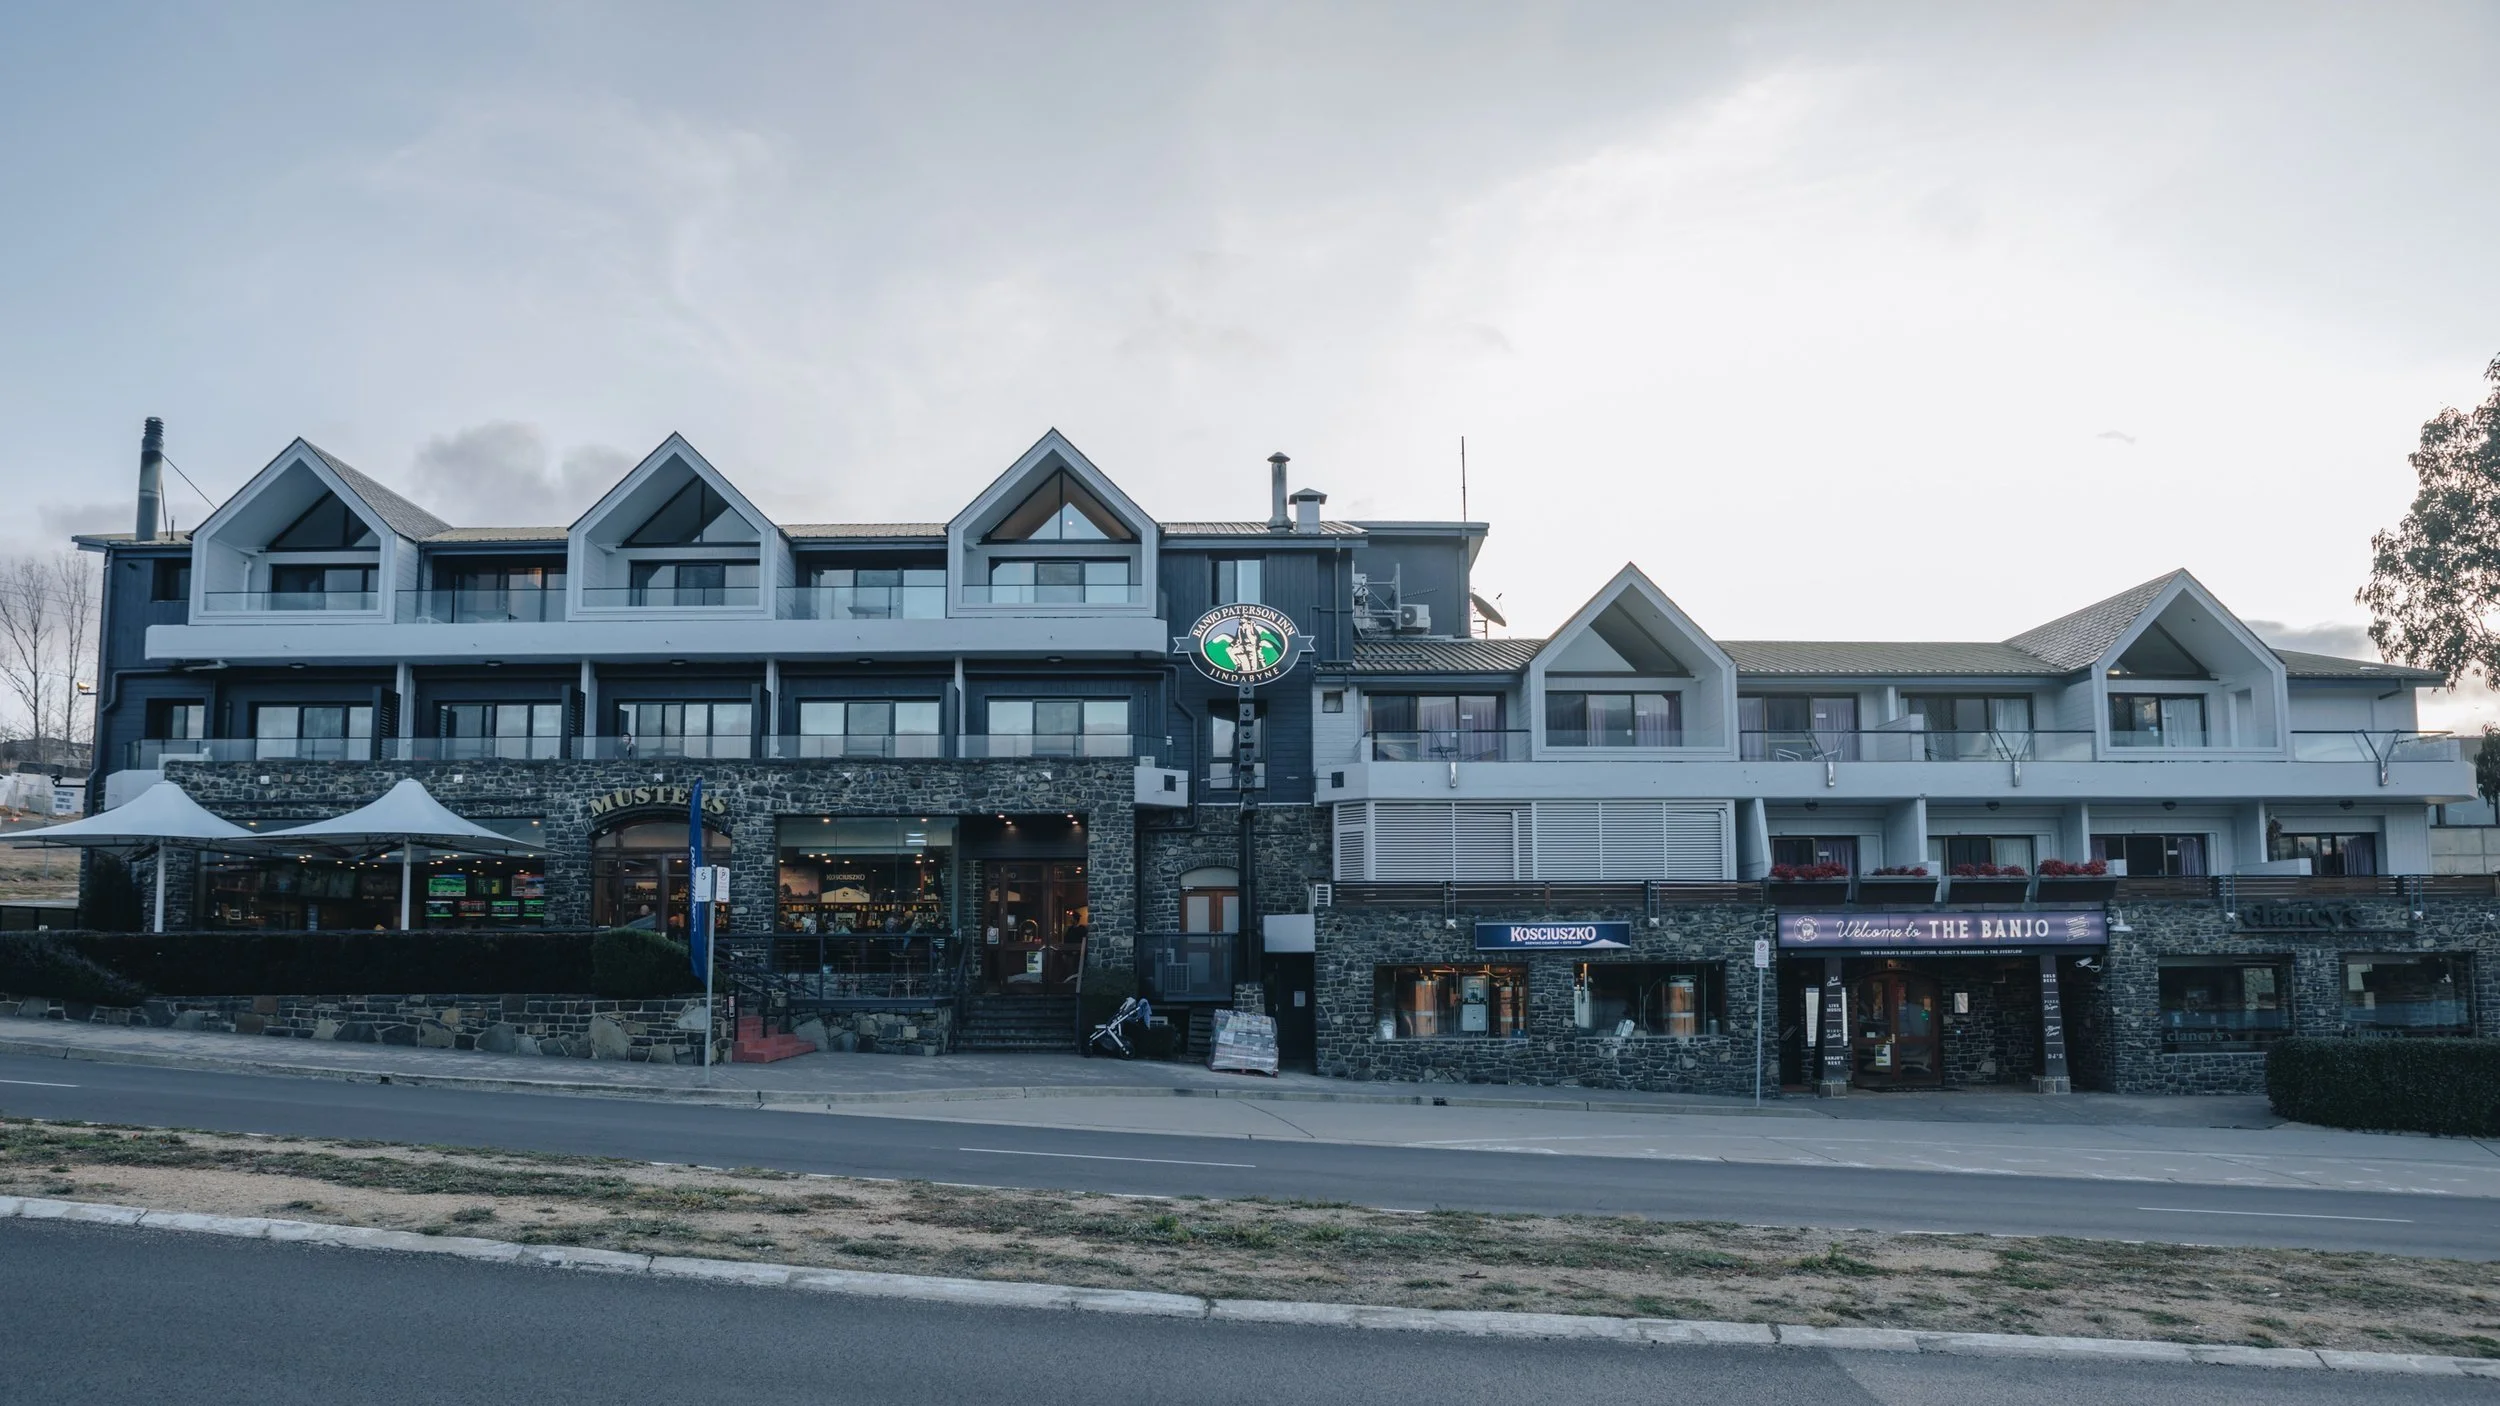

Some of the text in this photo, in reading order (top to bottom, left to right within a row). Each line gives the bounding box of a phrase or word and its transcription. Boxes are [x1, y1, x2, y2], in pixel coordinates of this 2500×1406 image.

[1192, 605, 1296, 638] BANJO PATERSON INN
[1209, 667, 1280, 682] JINDABYNE
[1510, 926, 1597, 942] KOSCIUSZKO
[1836, 920, 1902, 938] Welcome
[1904, 921, 1922, 938] to
[1928, 919, 1970, 940] THE
[1981, 918, 2050, 938] BANJO
